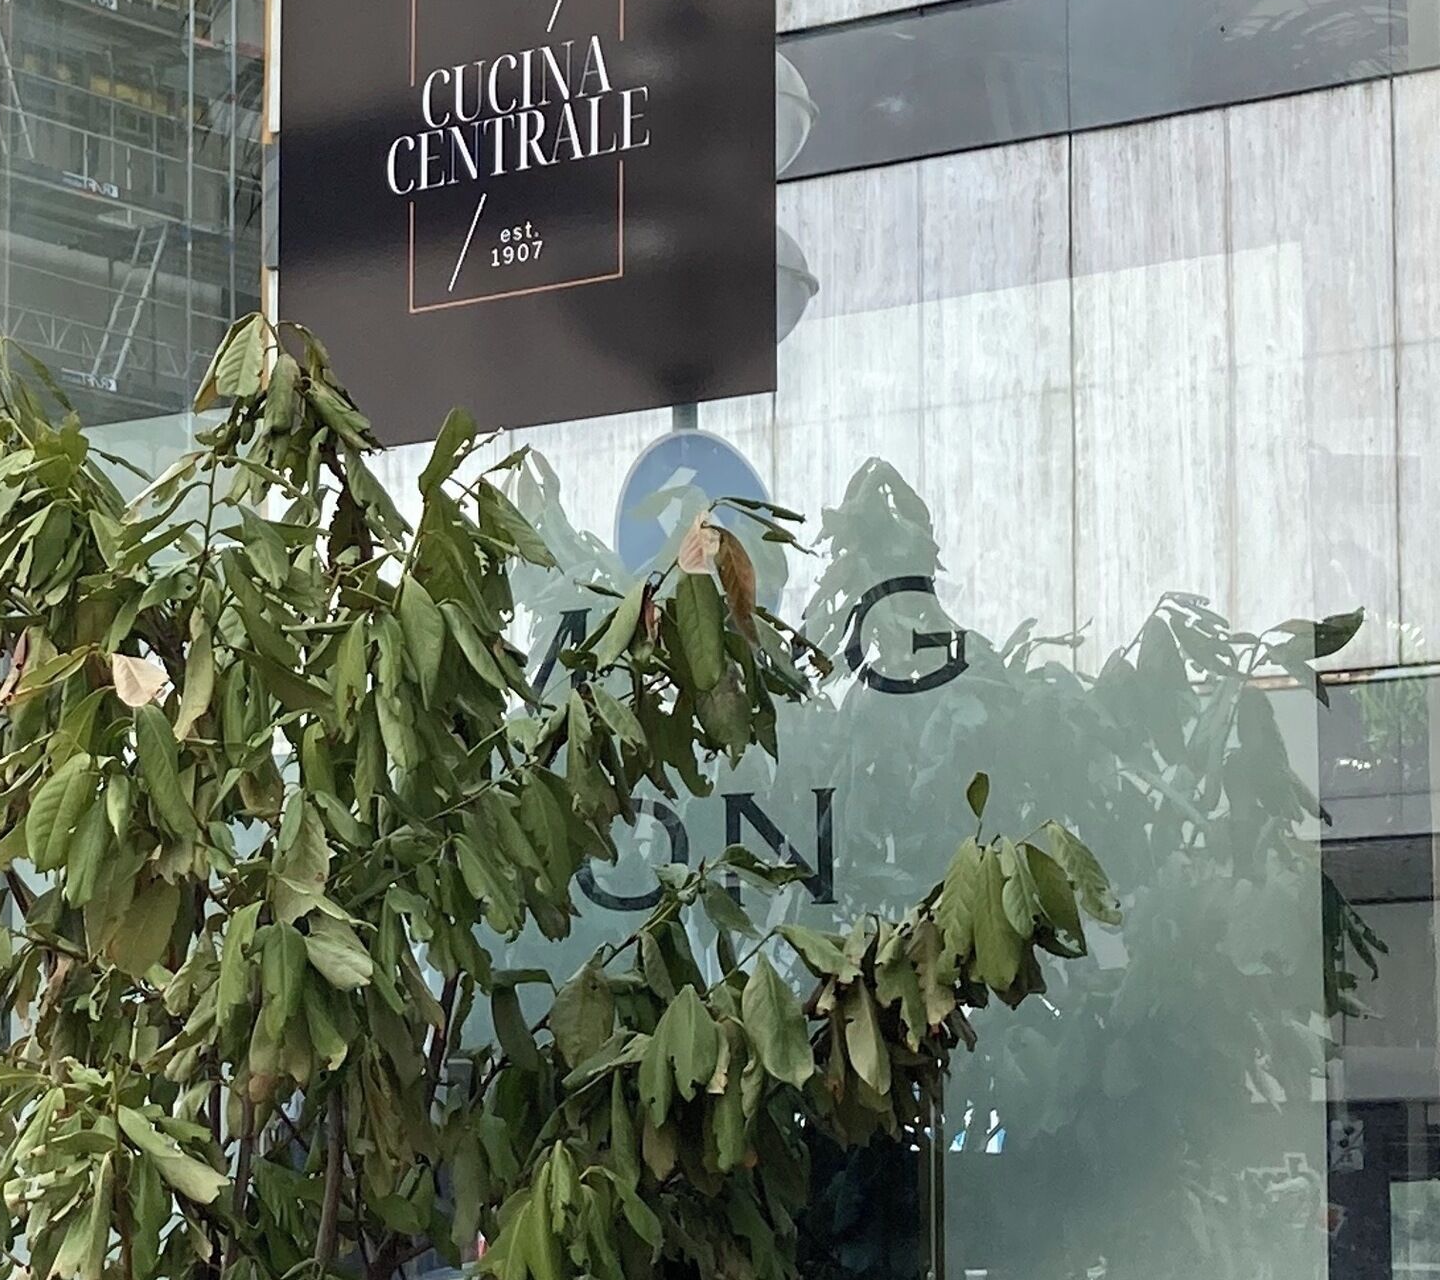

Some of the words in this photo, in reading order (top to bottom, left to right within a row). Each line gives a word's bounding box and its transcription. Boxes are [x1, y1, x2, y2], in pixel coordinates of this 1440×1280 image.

[421, 35, 613, 129] CUCINA
[385, 86, 651, 197] CENTRALE
[490, 240, 544, 267] 1907
[499, 220, 541, 241] est.
